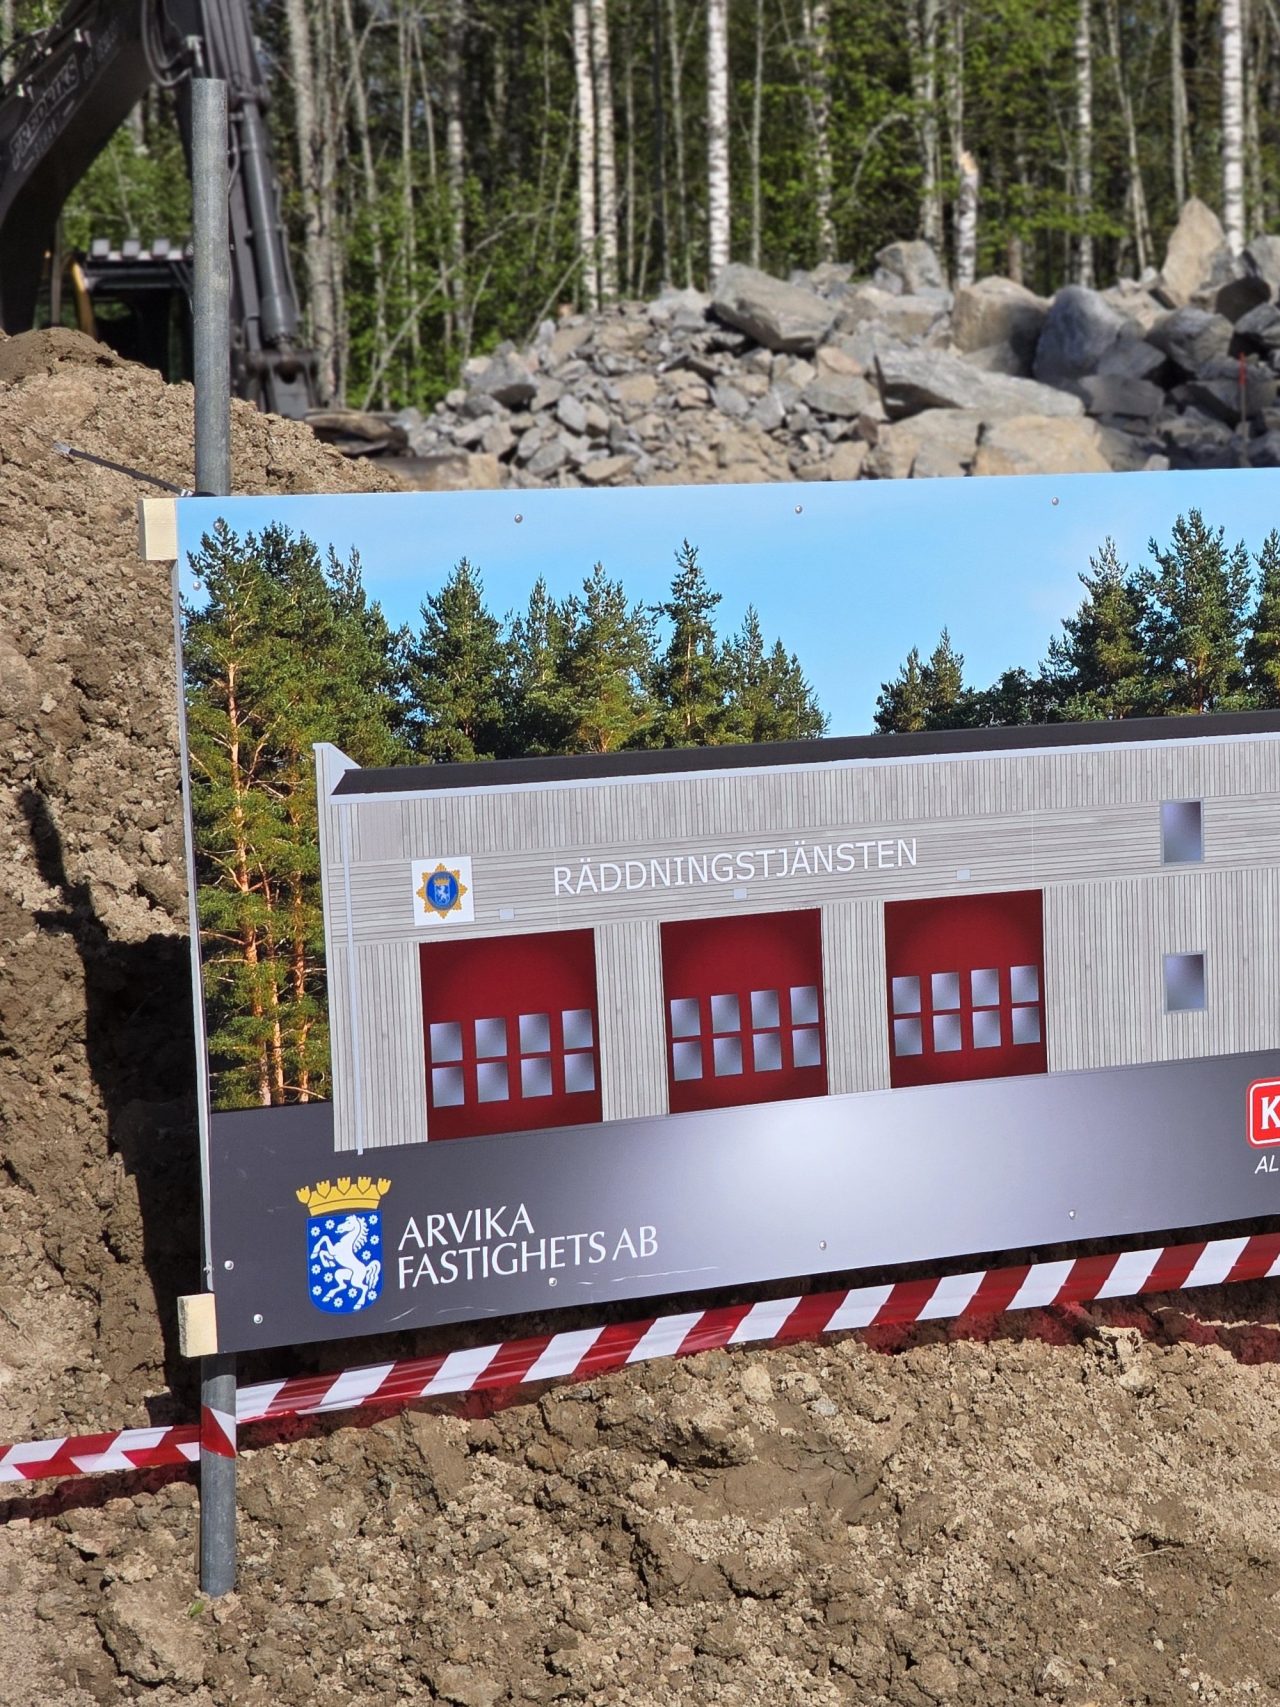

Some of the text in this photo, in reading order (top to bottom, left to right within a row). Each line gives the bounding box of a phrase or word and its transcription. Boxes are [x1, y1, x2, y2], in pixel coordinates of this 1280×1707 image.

[554, 838, 917, 896] RÄDDNINGSTJÄNSTEN
[398, 1203, 535, 1251] ARVIKA
[398, 1225, 659, 1290] FASTIGHETS AB
